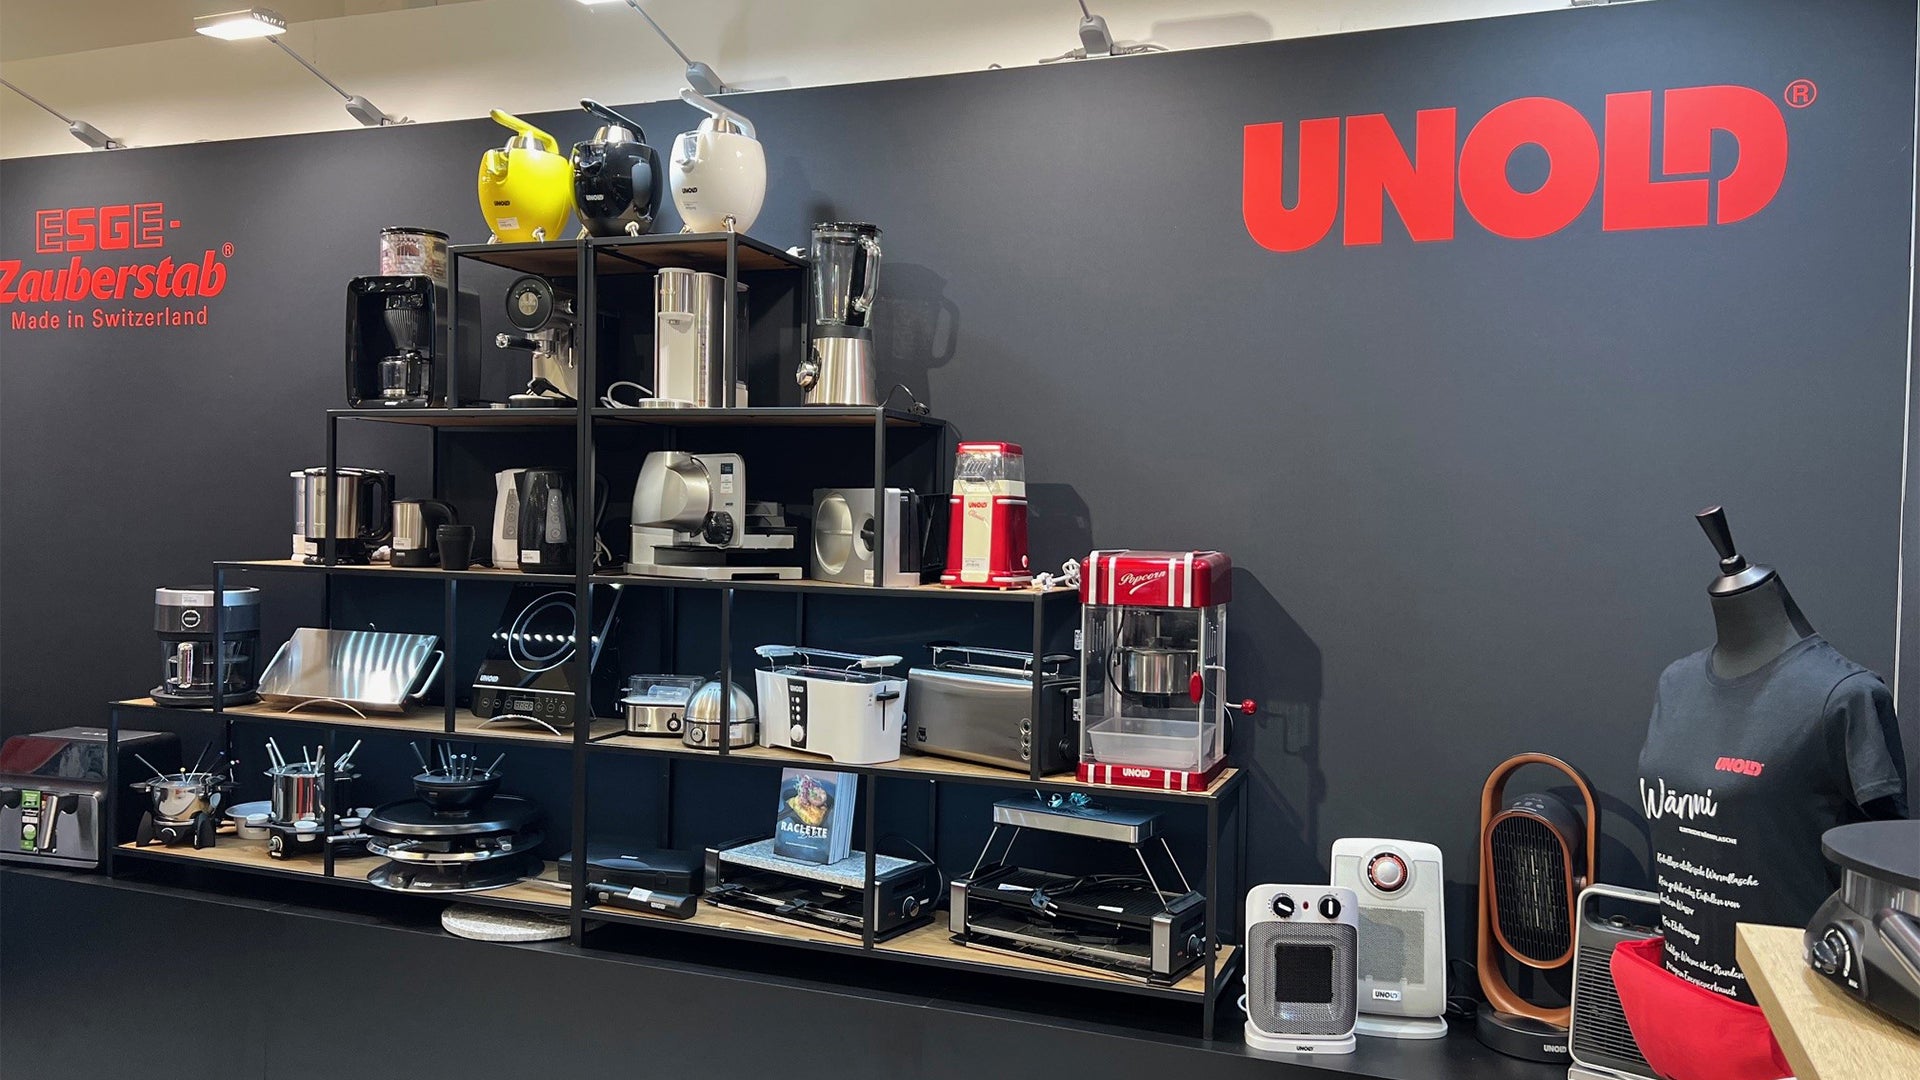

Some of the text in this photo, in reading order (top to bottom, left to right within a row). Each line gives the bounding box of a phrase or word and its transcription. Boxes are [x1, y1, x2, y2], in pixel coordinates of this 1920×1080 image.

[11, 306, 208, 330] Made in Switzerland
[1118, 571, 1166, 586] Popcorn
[1122, 767, 1151, 778] UNOLD
[780, 820, 828, 839] RACLETTE
[1374, 990, 1399, 999] UNOLD
[1543, 1044, 1567, 1053] UNOLD
